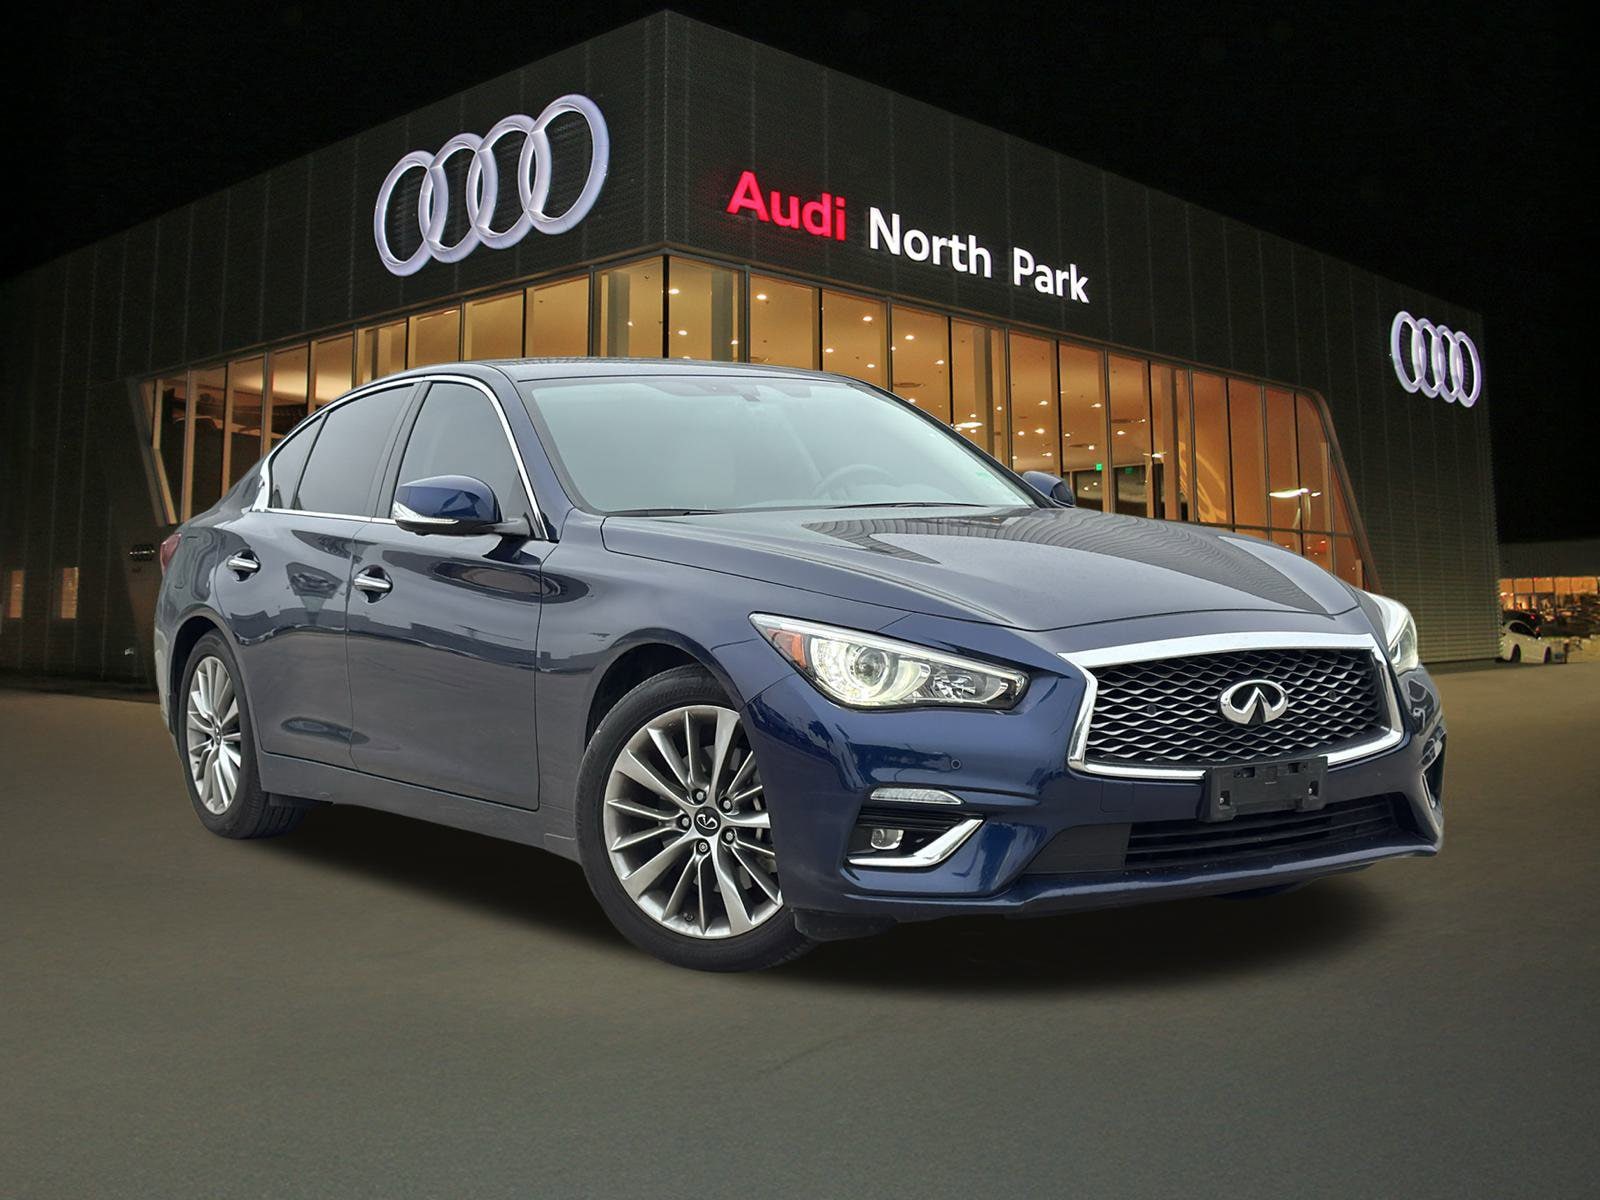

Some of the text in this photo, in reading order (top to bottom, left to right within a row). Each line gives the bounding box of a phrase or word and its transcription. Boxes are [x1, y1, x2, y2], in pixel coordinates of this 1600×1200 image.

[726, 171, 1090, 303] Audi North Park
